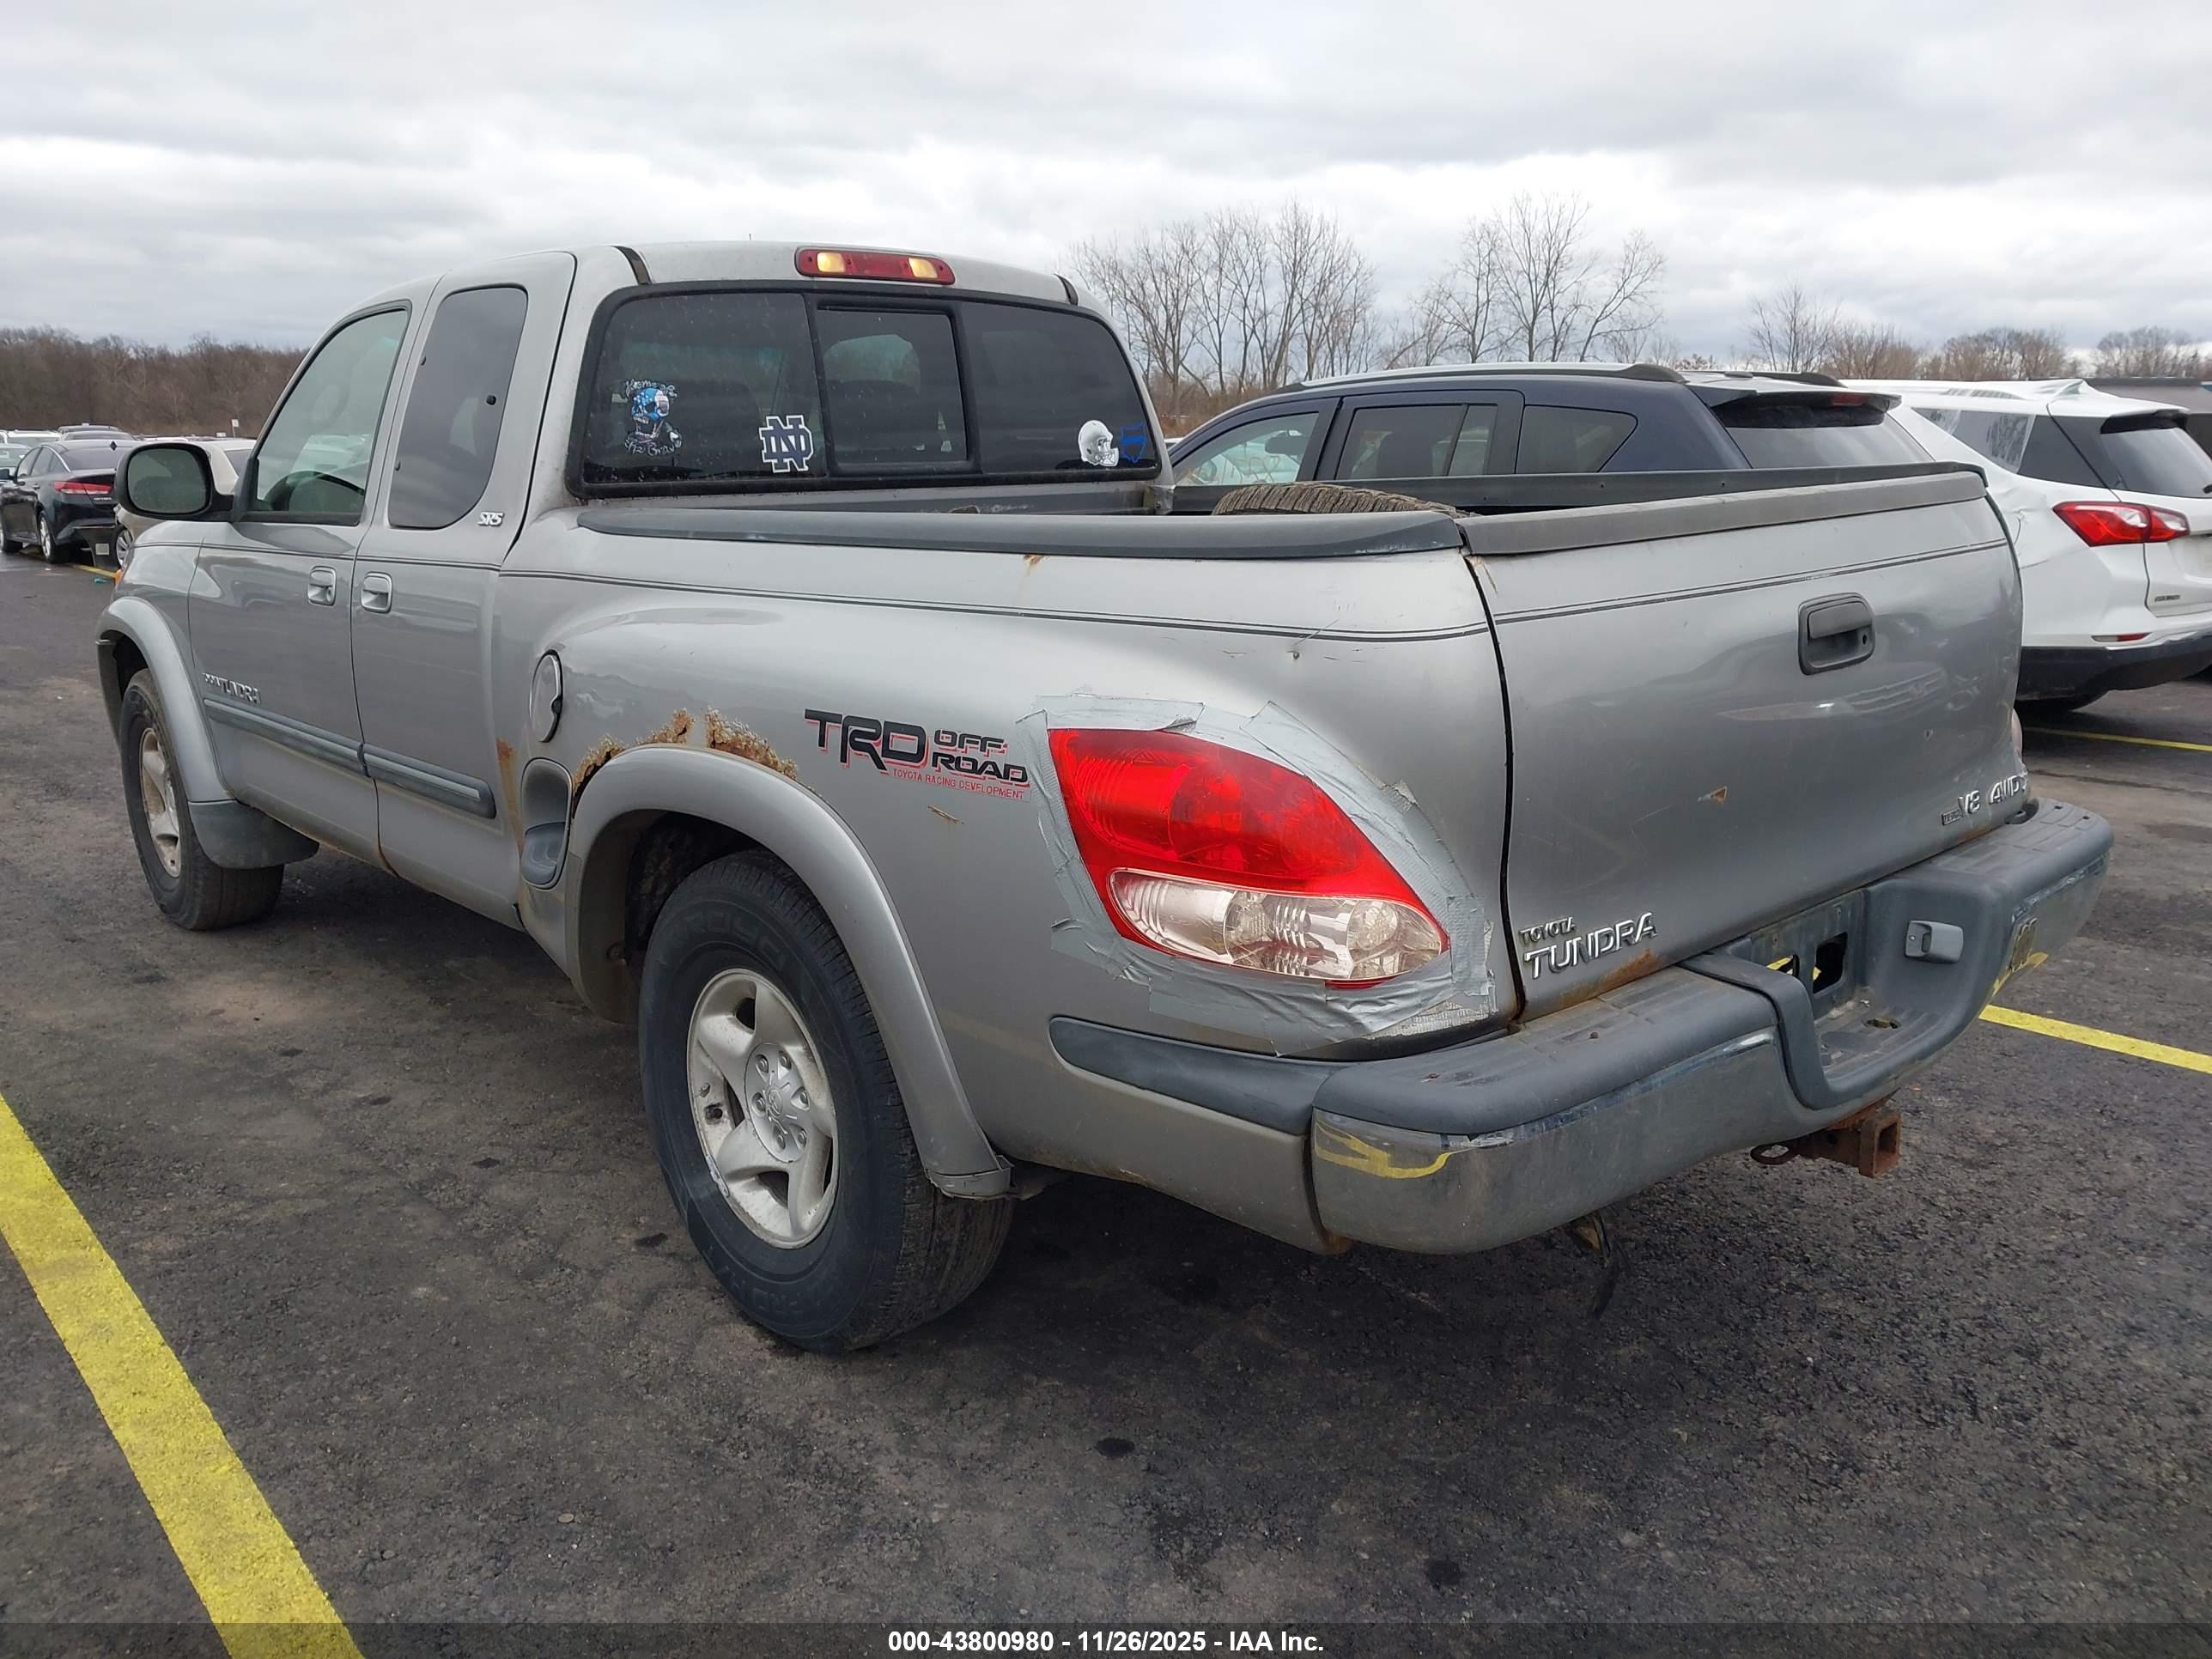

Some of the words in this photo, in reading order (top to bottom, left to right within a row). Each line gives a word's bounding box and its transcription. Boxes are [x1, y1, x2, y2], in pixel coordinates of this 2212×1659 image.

[477, 512, 504, 526] SR5
[805, 708, 929, 775] TRD
[933, 729, 1006, 757] OFF
[892, 768, 923, 782] TOYOTA
[924, 775, 957, 789] RACING
[958, 779, 1024, 800] DEVELOPMENT
[932, 751, 1030, 787] ROAD
[1519, 916, 1577, 944] TOYOTA
[1523, 912, 1658, 980] TUNDRA
